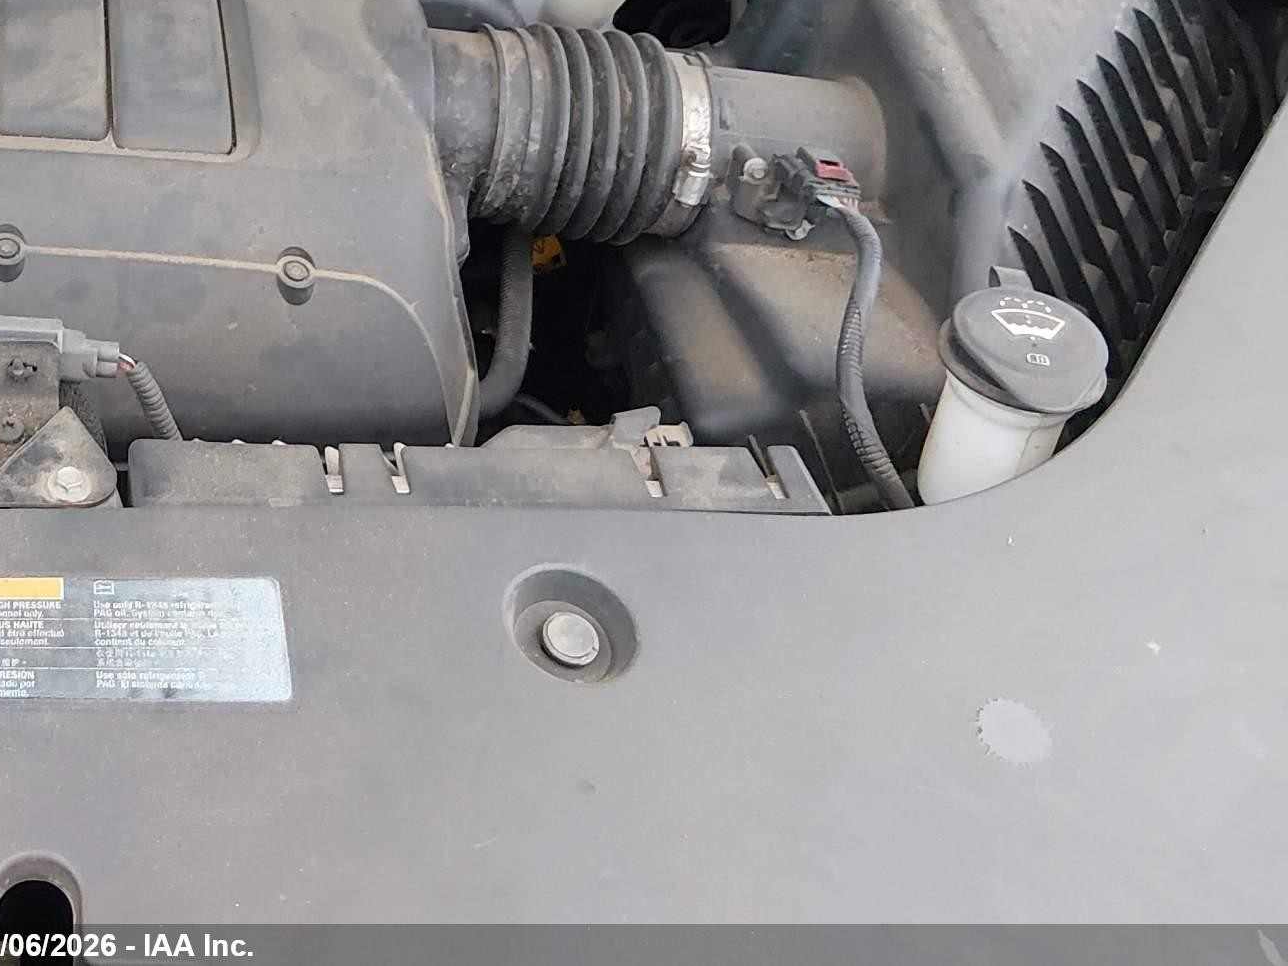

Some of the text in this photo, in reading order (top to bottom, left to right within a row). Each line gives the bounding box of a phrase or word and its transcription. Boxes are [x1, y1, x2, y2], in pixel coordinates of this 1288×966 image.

[13, 601, 62, 609] PRESSURE
[23, 610, 45, 619] only.
[13, 621, 45, 629] HAUTE
